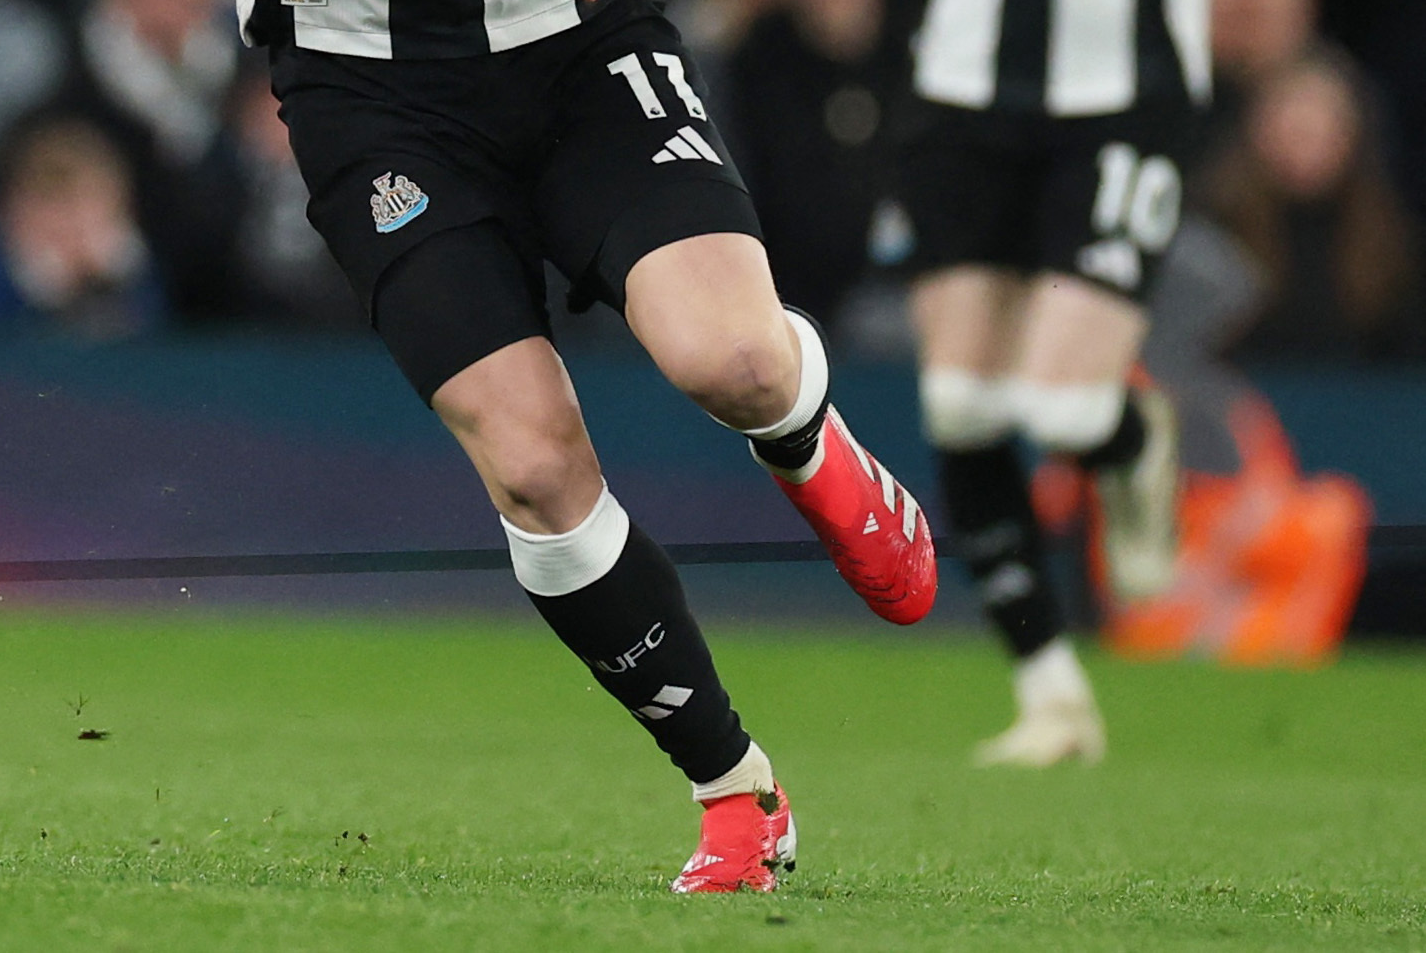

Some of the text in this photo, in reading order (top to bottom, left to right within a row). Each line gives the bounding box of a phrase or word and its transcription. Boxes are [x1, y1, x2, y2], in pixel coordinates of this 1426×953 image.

[606, 52, 708, 122] 11
[1090, 142, 1182, 249] 10
[596, 622, 666, 673] UFC
